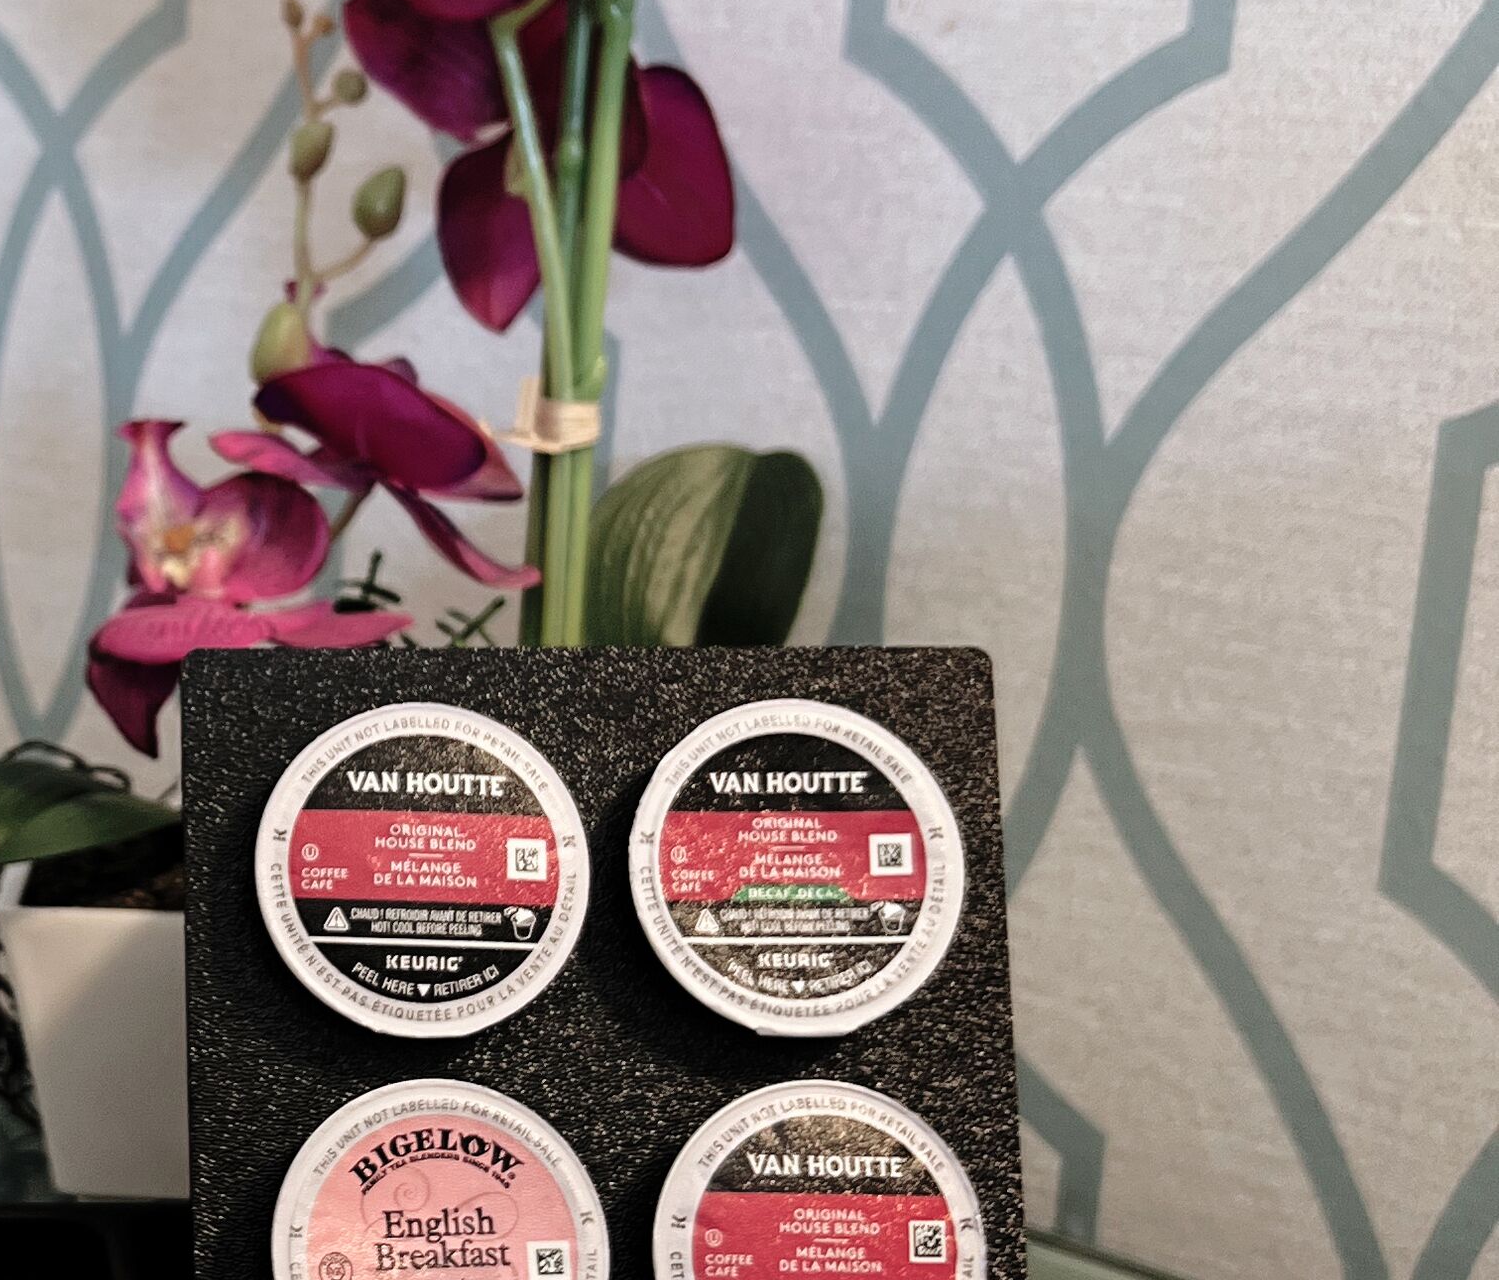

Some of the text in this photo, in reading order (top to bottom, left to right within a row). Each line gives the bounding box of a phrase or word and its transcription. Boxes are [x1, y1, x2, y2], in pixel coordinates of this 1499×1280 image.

[301, 757, 326, 784] THIS
[324, 737, 353, 761] UNIT
[354, 725, 380, 743] NOT
[454, 721, 481, 738] FOR
[520, 760, 549, 791] SALE
[687, 736, 715, 762] UNIT
[882, 754, 912, 784] SALE
[347, 771, 505, 797] VAN HOUTTE
[709, 771, 867, 795] VAN HOUTTE
[389, 823, 463, 838] ORIGINAL
[752, 817, 821, 829] ORIGINAL
[738, 830, 838, 842] HOUSE BLEND
[375, 837, 477, 852] HOUSE BLEND
[301, 868, 348, 879] COFFEE
[390, 859, 462, 874] MÉLANGE
[739, 866, 841, 879] DE LA MAISON
[373, 873, 478, 888] DE LA MAISON
[671, 870, 715, 881] COFFEE
[301, 878, 333, 890] CAFÉ
[748, 888, 790, 899] DECAF
[270, 863, 286, 909] CETTE
[280, 912, 309, 955] UNITÉ
[340, 986, 367, 1007] PAS
[370, 999, 451, 1022] ÉTIQUETÉE
[457, 995, 496, 1018] POUR
[498, 984, 516, 1000] LA
[515, 947, 551, 986] VENTE
[557, 872, 577, 922] DÉTAIL
[640, 867, 657, 912] CETTE
[652, 914, 683, 957] UNITÉ
[717, 986, 744, 1006] PAS
[928, 864, 946, 913] DÉTAIL
[386, 954, 461, 971] KEURIG
[758, 952, 834, 968] KEURIG
[352, 962, 379, 987] PEEL
[382, 977, 415, 995] HERE
[433, 974, 483, 996] RETIRER
[313, 1147, 337, 1176] THIS
[335, 1123, 363, 1149] UNIT
[363, 1109, 389, 1129] NOT
[392, 1098, 459, 1117] LABELLED
[463, 1101, 490, 1117] FOR
[698, 1140, 723, 1168] THIS
[722, 1118, 750, 1142] UNIT
[779, 1096, 845, 1112] LABELLED
[747, 1152, 906, 1179] VAN HOUTTE
[361, 1169, 388, 1196] FAMILY
[391, 1160, 407, 1172] TEA
[409, 1152, 460, 1163] BLENDERS
[462, 1156, 491, 1173] SINCE
[793, 1208, 865, 1221] ORIGINAL
[381, 1206, 496, 1243] English
[779, 1222, 881, 1236] HOUSE BLEND
[375, 1242, 511, 1272] Breakfast
[796, 1245, 866, 1259] MÉLANGE
[705, 1254, 754, 1266] COFFEE
[779, 1260, 884, 1273] DE LA MAISON
[705, 1265, 739, 1278] CAFÉ
